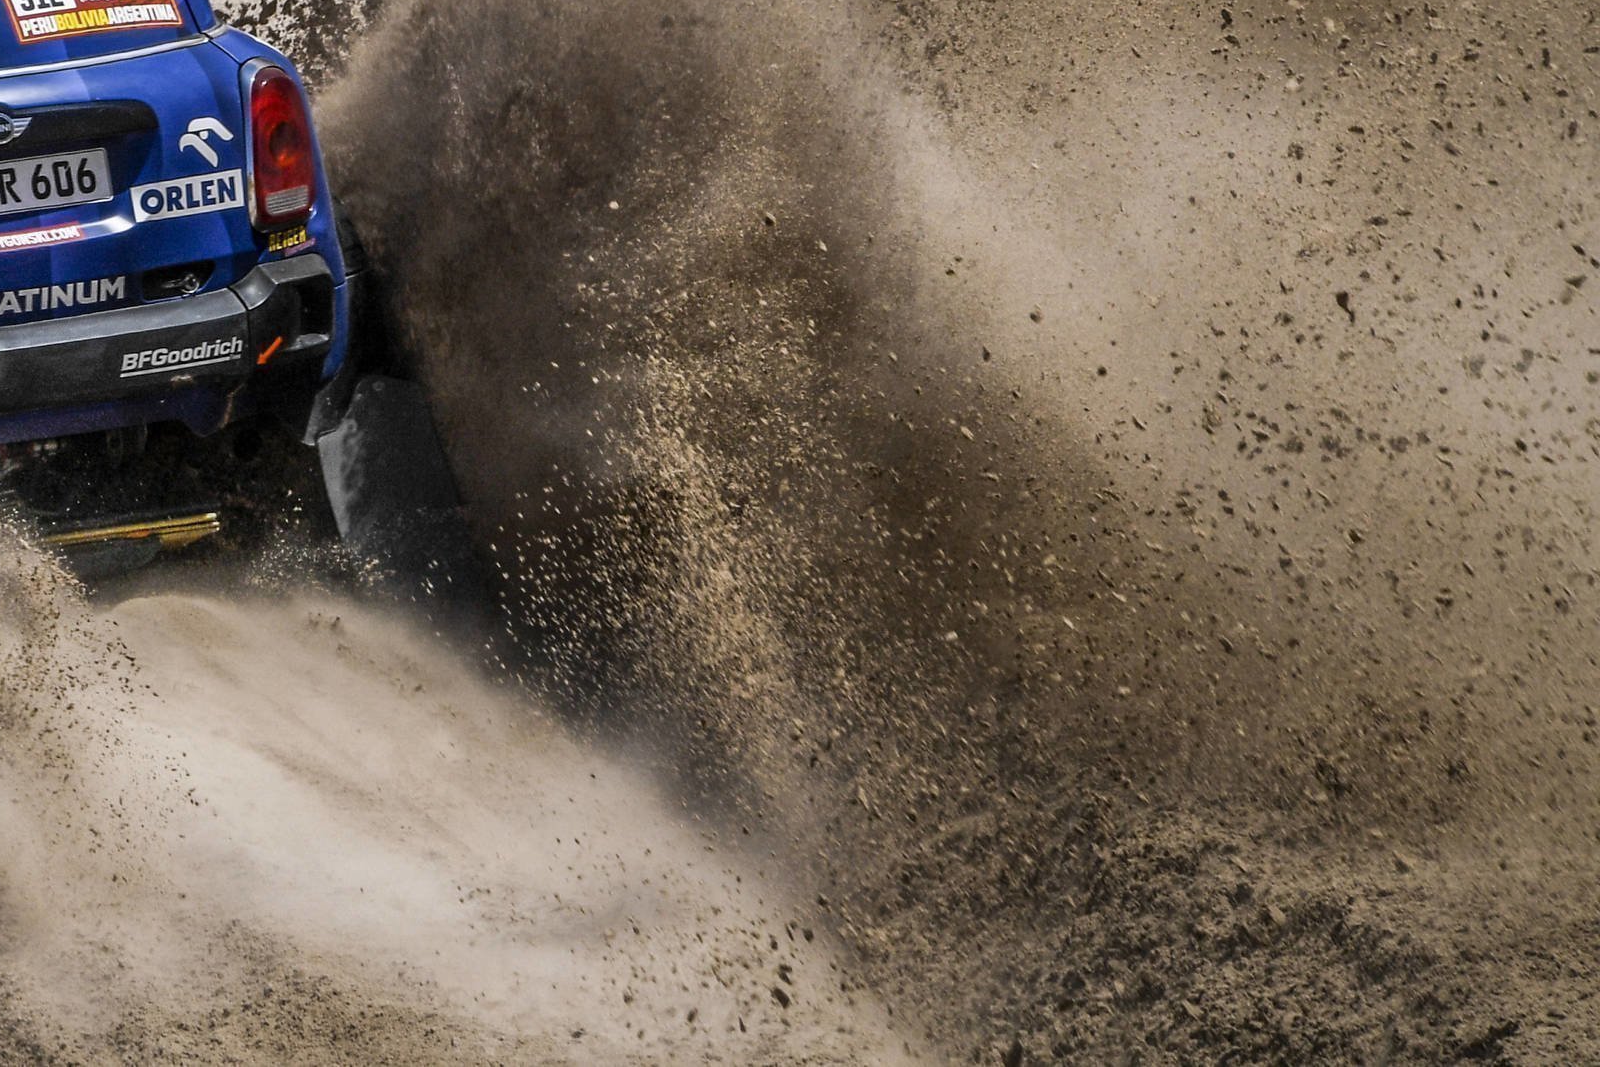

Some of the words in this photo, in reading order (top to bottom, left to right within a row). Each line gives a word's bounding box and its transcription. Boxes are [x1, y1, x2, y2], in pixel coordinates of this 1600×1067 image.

[31, 158, 97, 200] 606
[140, 176, 236, 214] ORLEN
[122, 336, 243, 372] BFGoodrich
